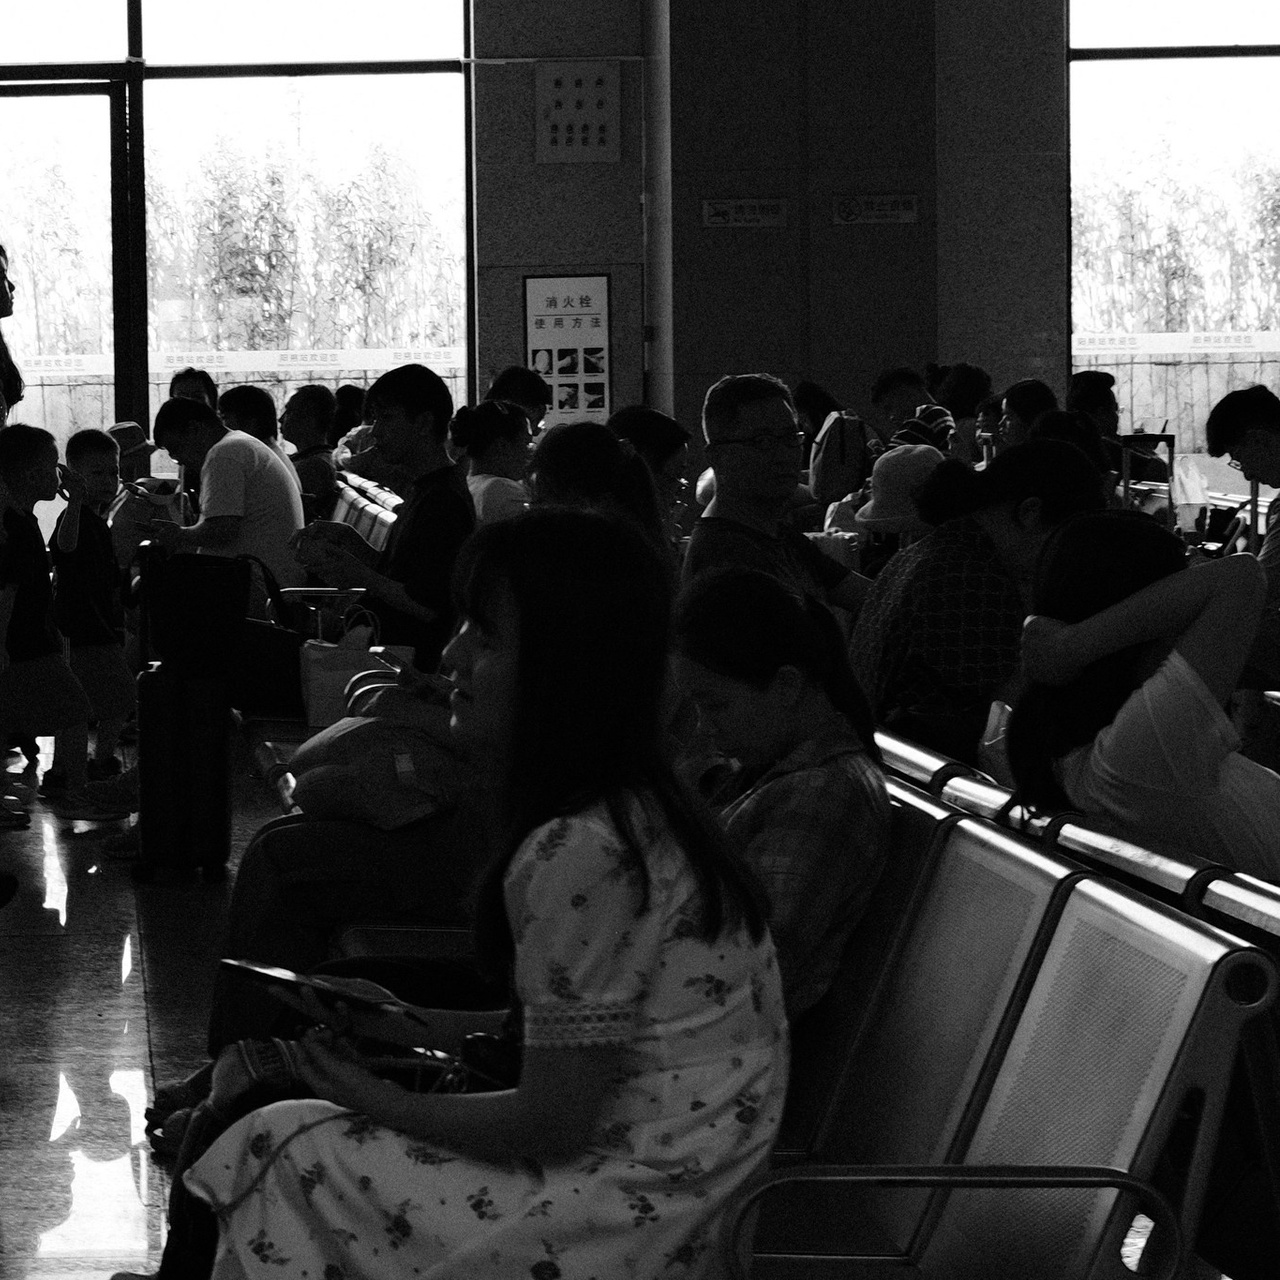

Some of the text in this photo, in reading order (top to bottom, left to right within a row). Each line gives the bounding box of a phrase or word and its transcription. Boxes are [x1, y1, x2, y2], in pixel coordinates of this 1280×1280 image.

[545, 295, 592, 309] 消火栓
[534, 317, 601, 330] 使用方法
